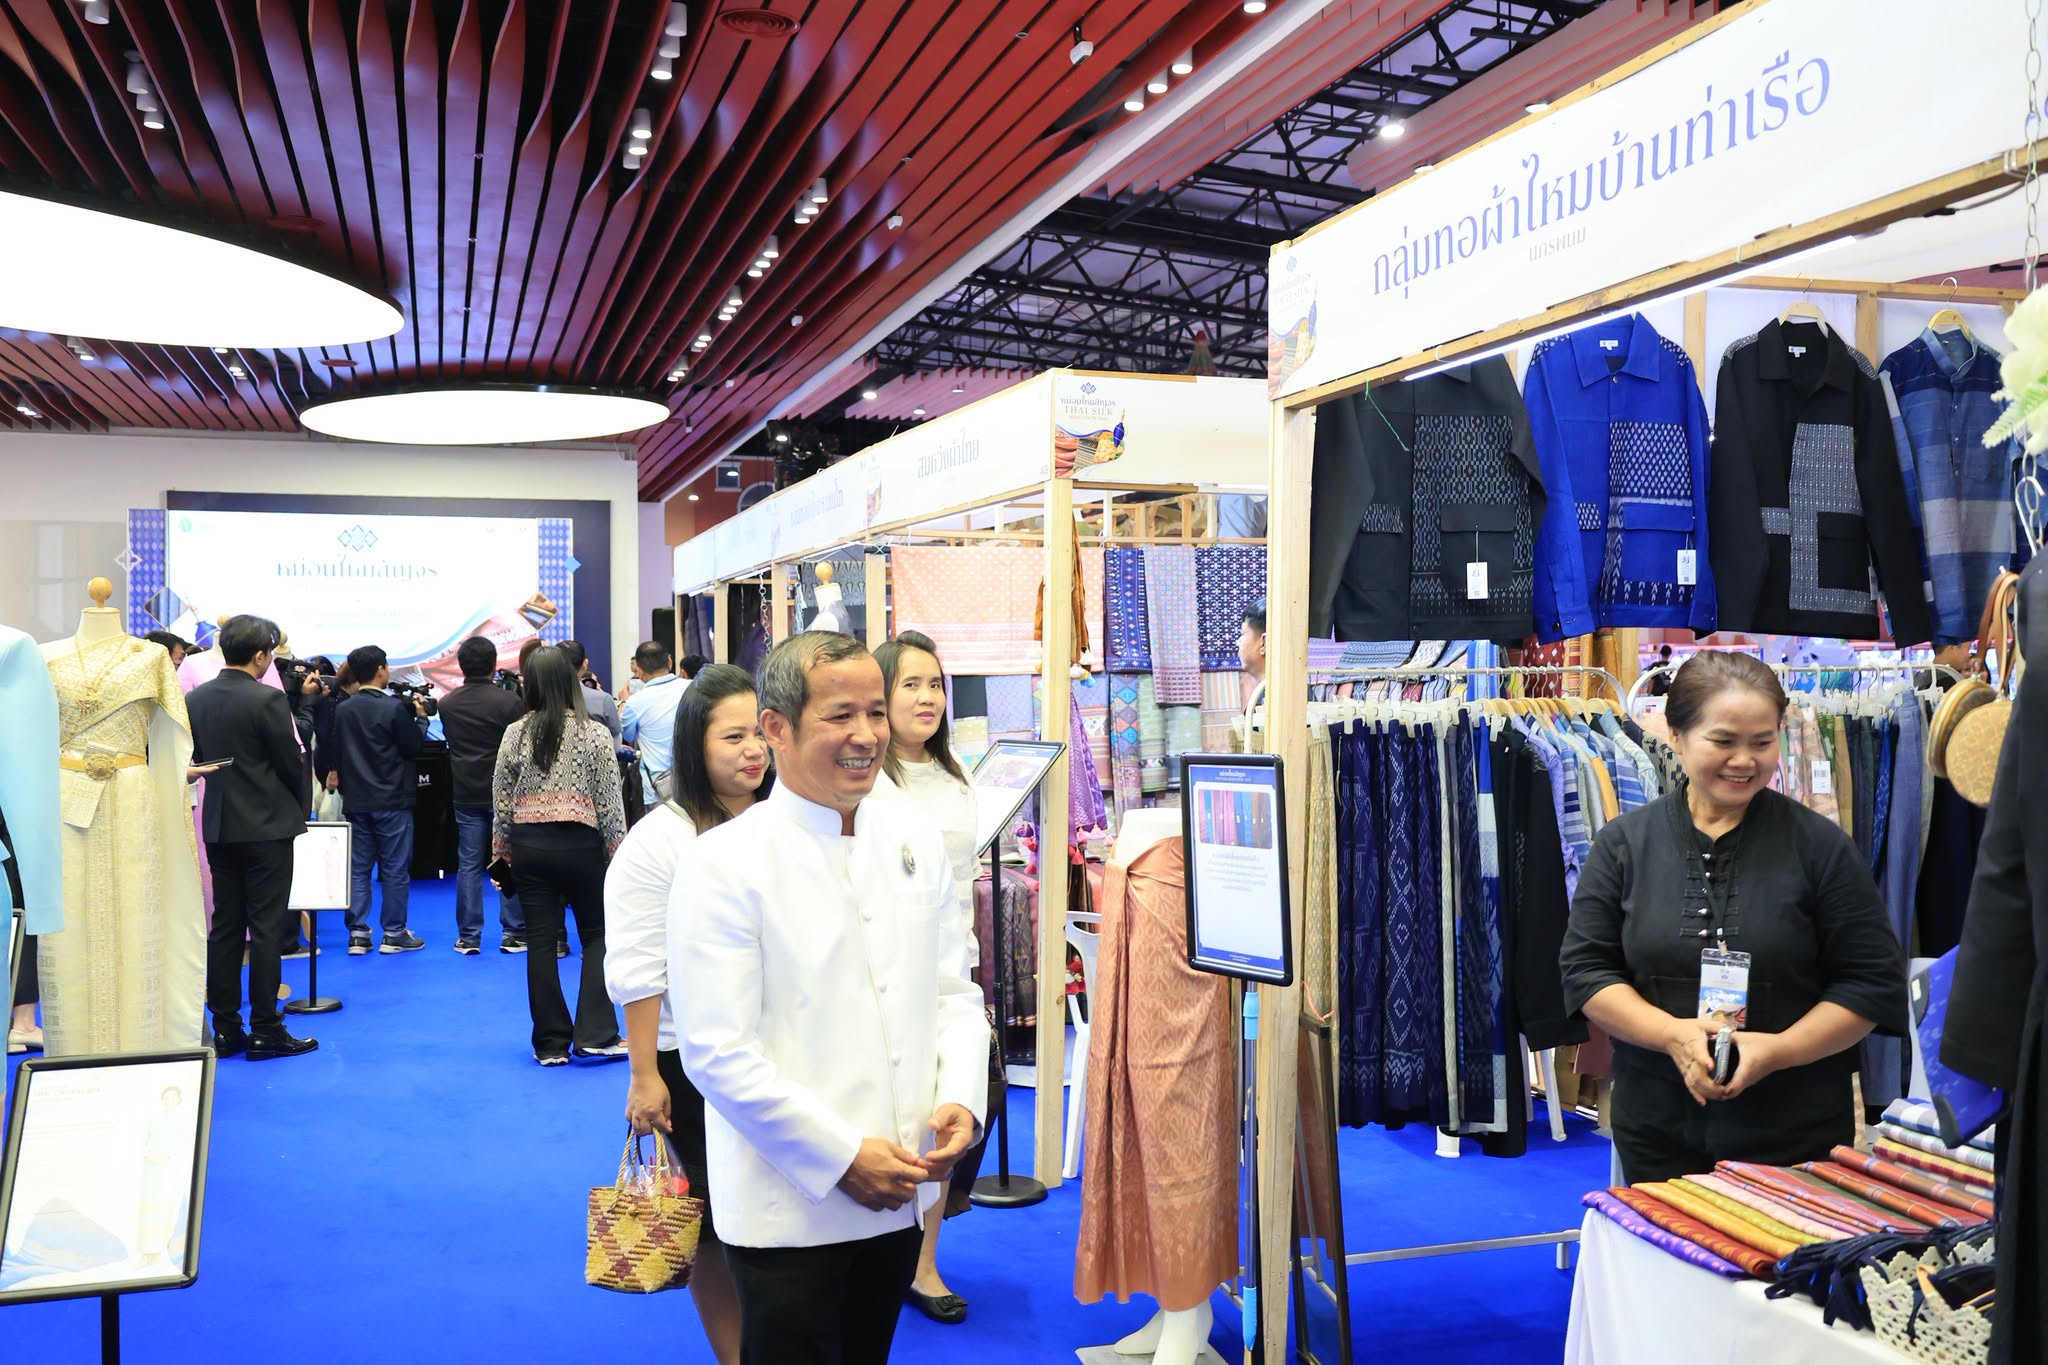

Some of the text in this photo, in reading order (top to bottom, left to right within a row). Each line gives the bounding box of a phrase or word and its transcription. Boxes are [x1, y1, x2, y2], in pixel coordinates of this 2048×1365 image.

[1373, 48, 1831, 299] กลุ่มทอผ้าไหมบ้านท่าเรือ
[1529, 226, 1586, 262] นครพนม
[1064, 405, 1113, 416] THAI SILK
